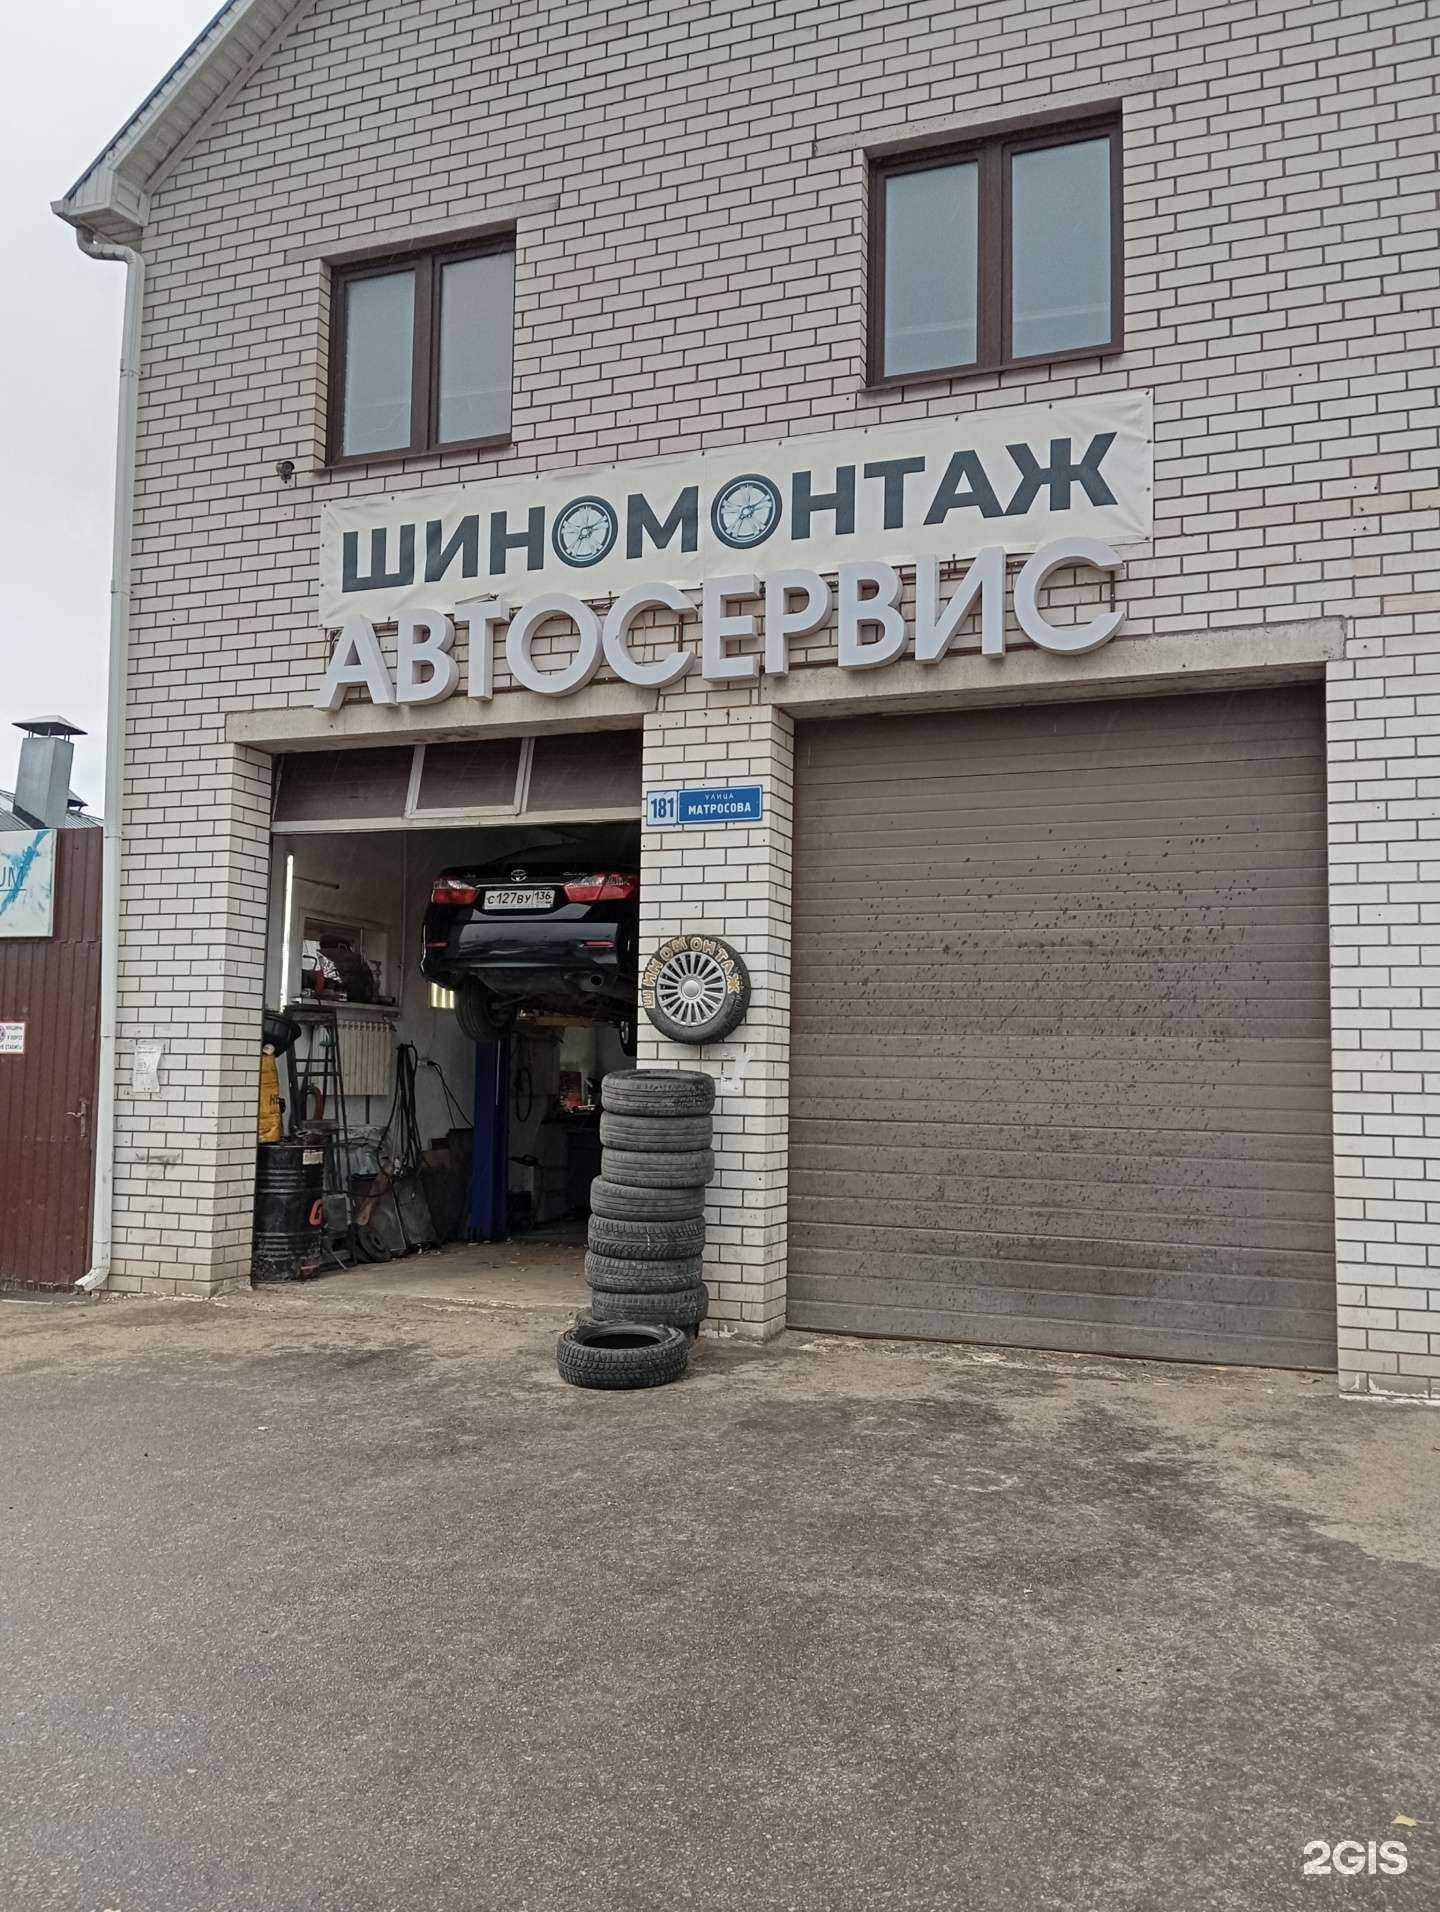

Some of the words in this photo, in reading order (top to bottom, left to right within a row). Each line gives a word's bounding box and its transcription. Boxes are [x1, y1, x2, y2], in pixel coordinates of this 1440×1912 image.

[342, 432, 1117, 593] ШИНОМОНТАЖ
[315, 537, 1125, 710] АВТОСЕРВИС
[651, 797, 674, 818] 181
[688, 802, 751, 815] МАТРОСОВА
